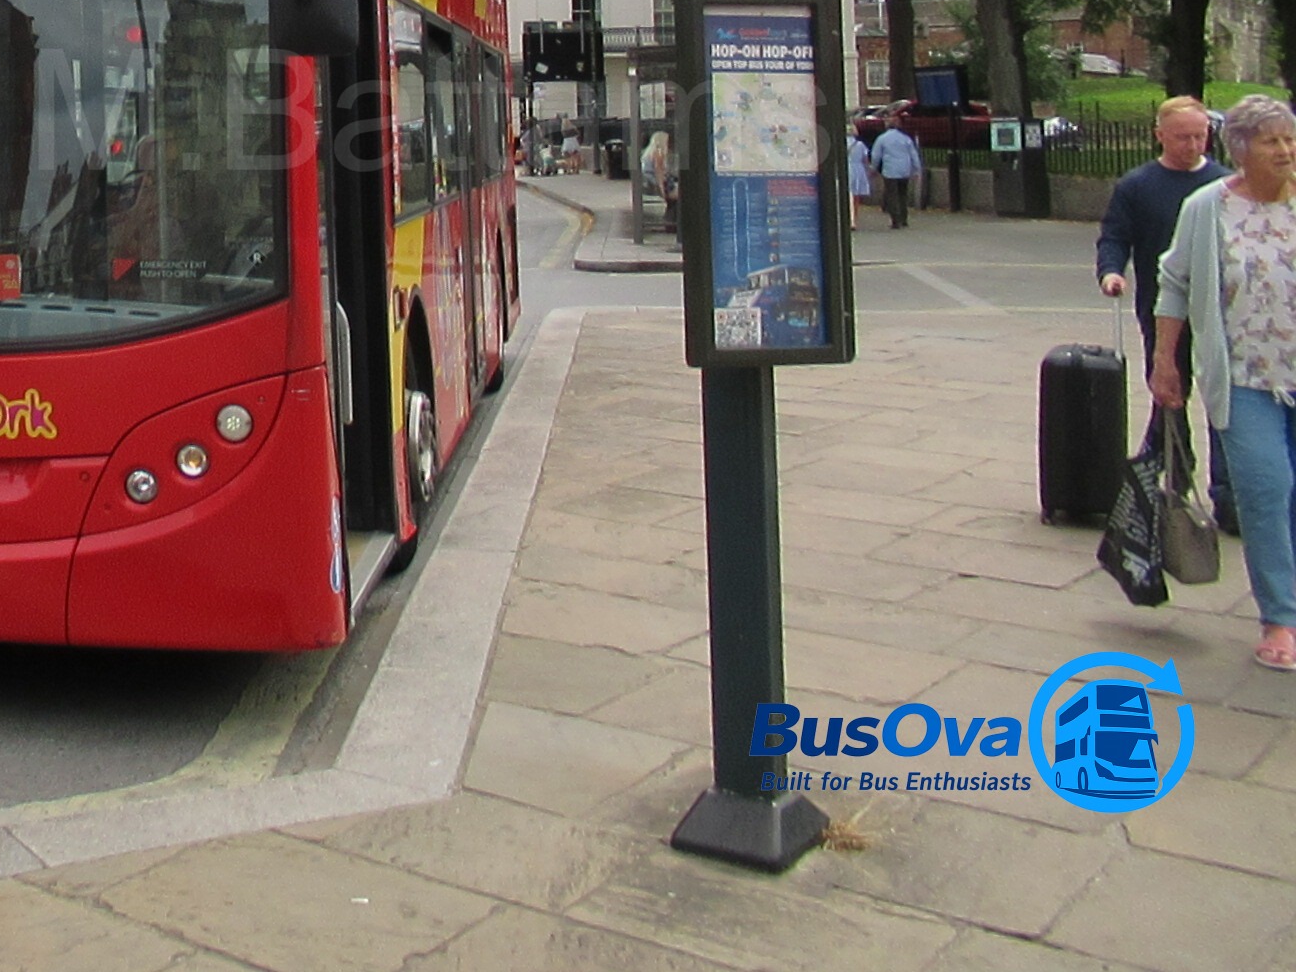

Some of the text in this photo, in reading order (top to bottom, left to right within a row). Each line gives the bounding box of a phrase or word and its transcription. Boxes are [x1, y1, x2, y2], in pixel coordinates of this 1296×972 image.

[711, 44, 761, 58] HOP-ON
[139, 260, 207, 269] EMERGENCY EXIT
[174, 270, 197, 278] OPEN
